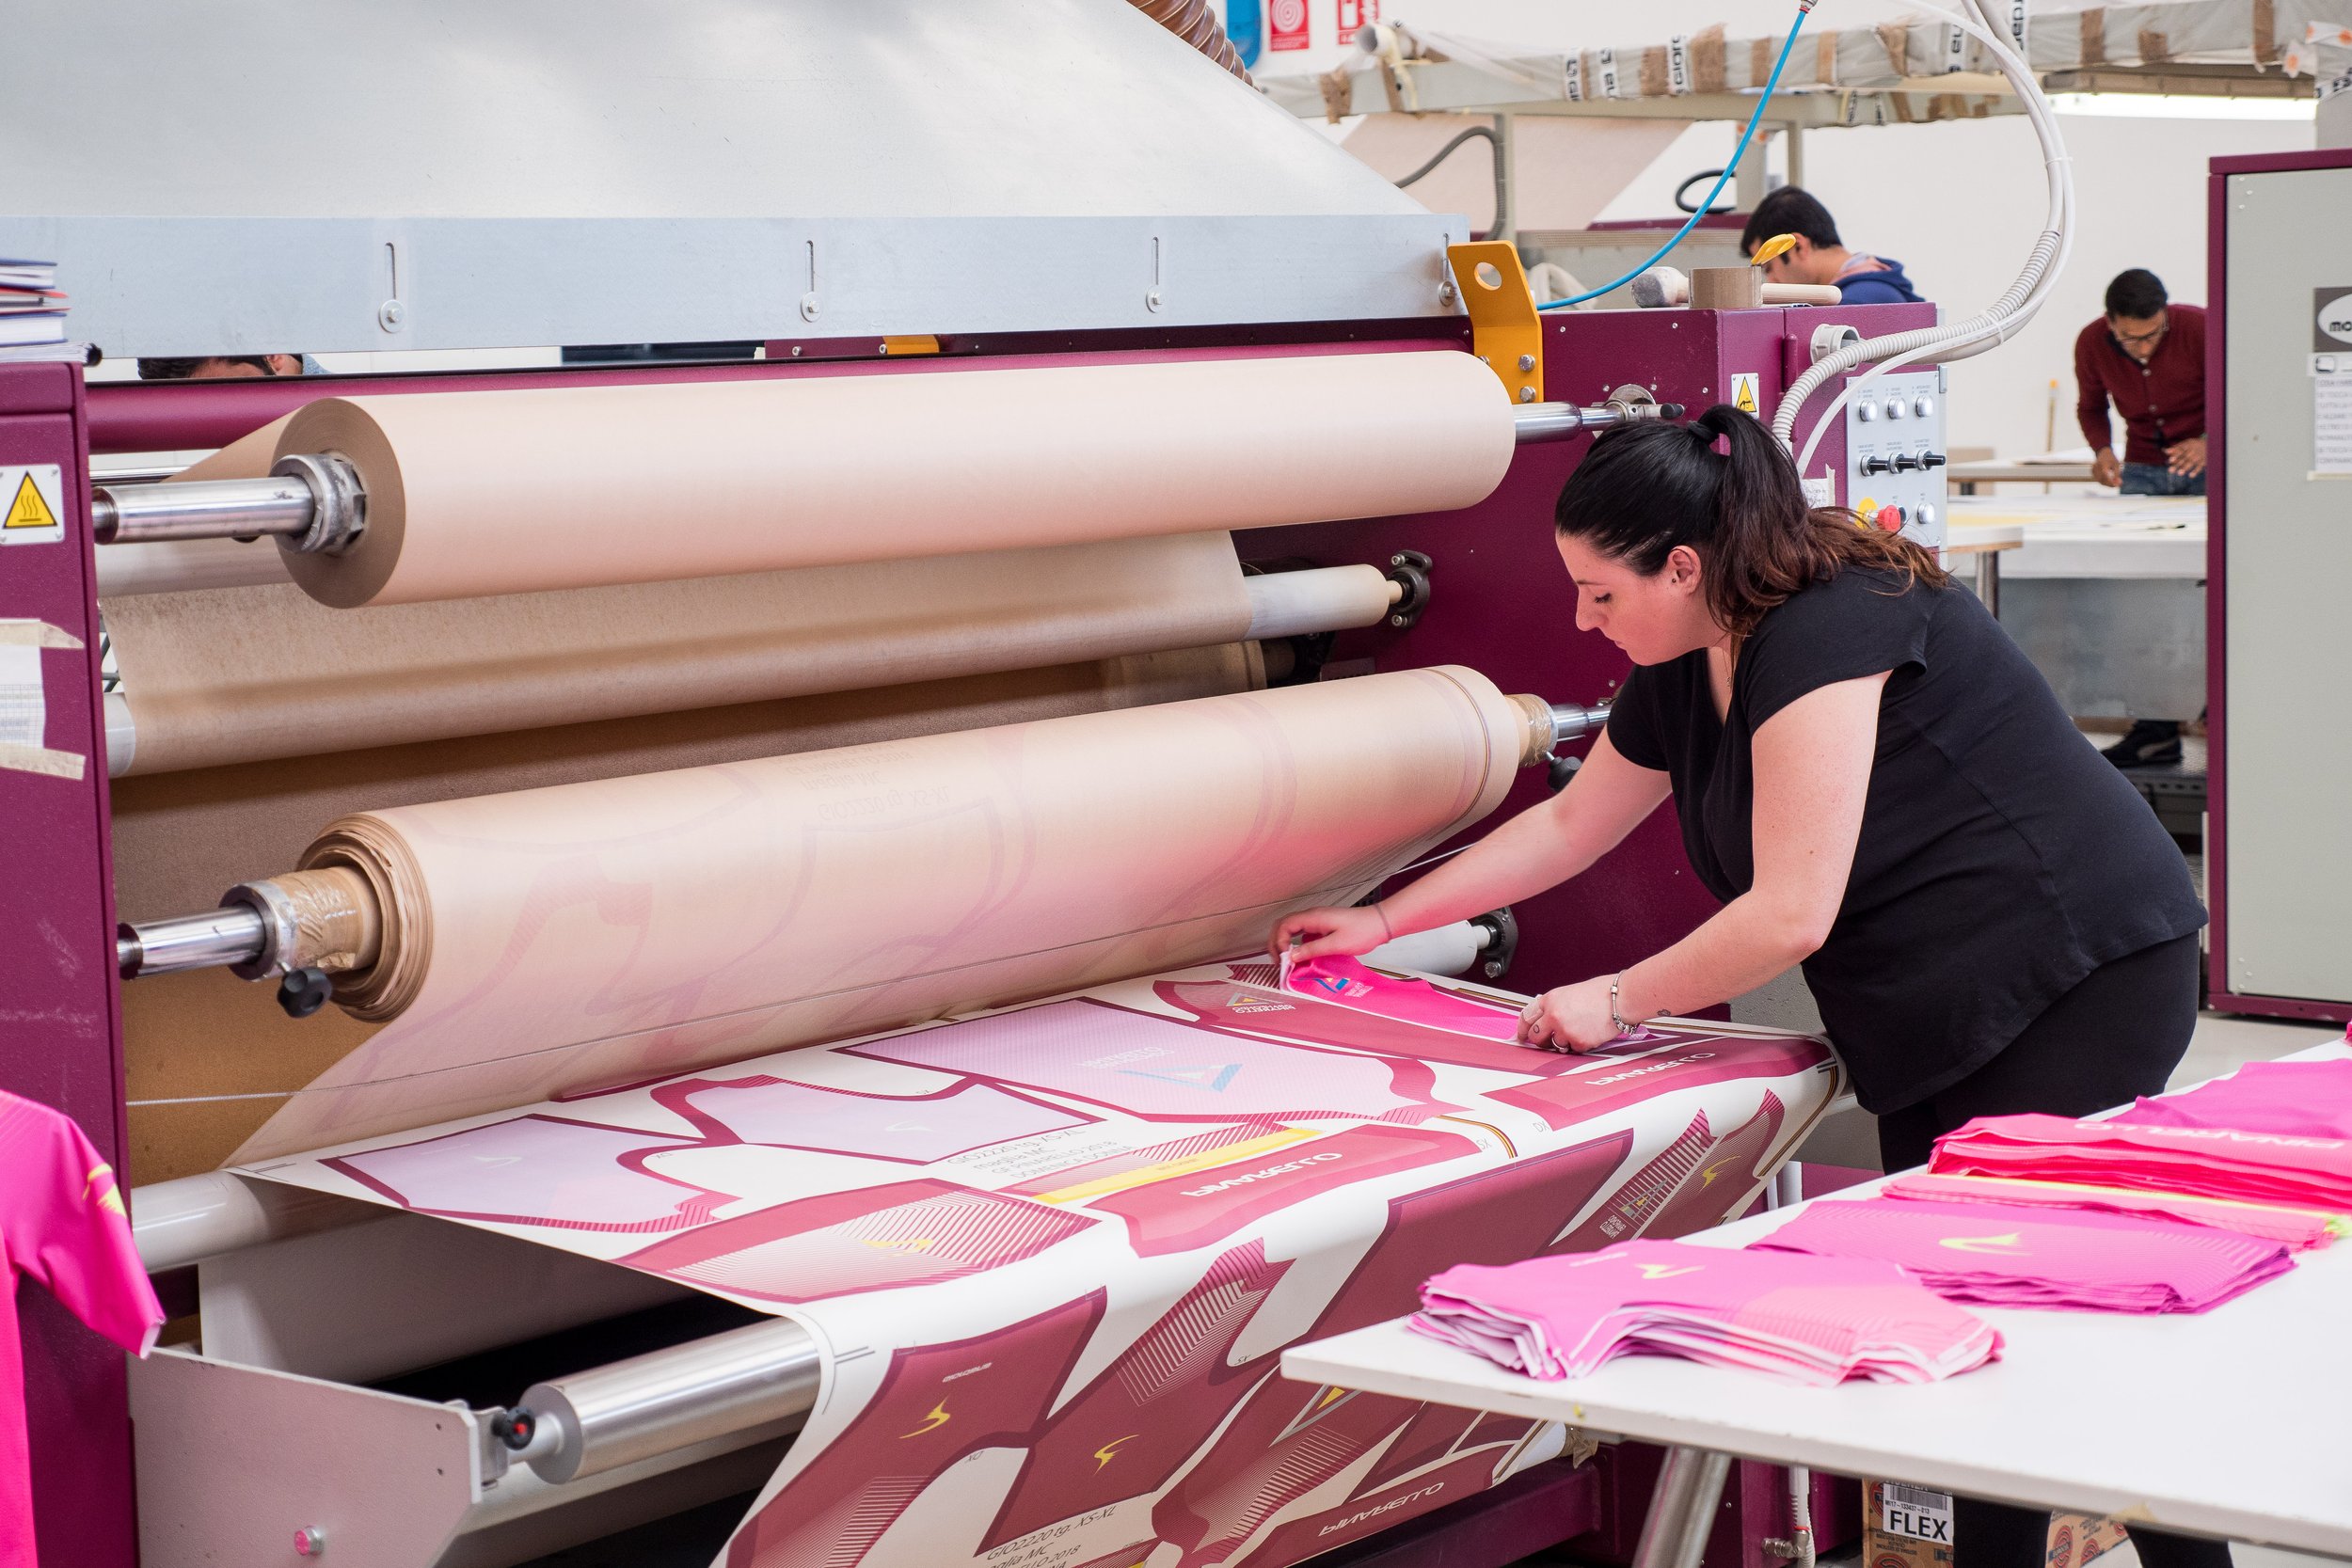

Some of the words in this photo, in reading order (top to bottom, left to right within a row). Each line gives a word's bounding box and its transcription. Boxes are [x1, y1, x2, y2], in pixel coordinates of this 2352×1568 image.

[987, 1528, 1054, 1560] GIO2220
[1073, 1506, 1117, 1529] XS-XL
[1890, 1510, 1947, 1542] FLEX
[1024, 1542, 1054, 1561] MC
[1048, 1544, 1081, 1563] 2018
